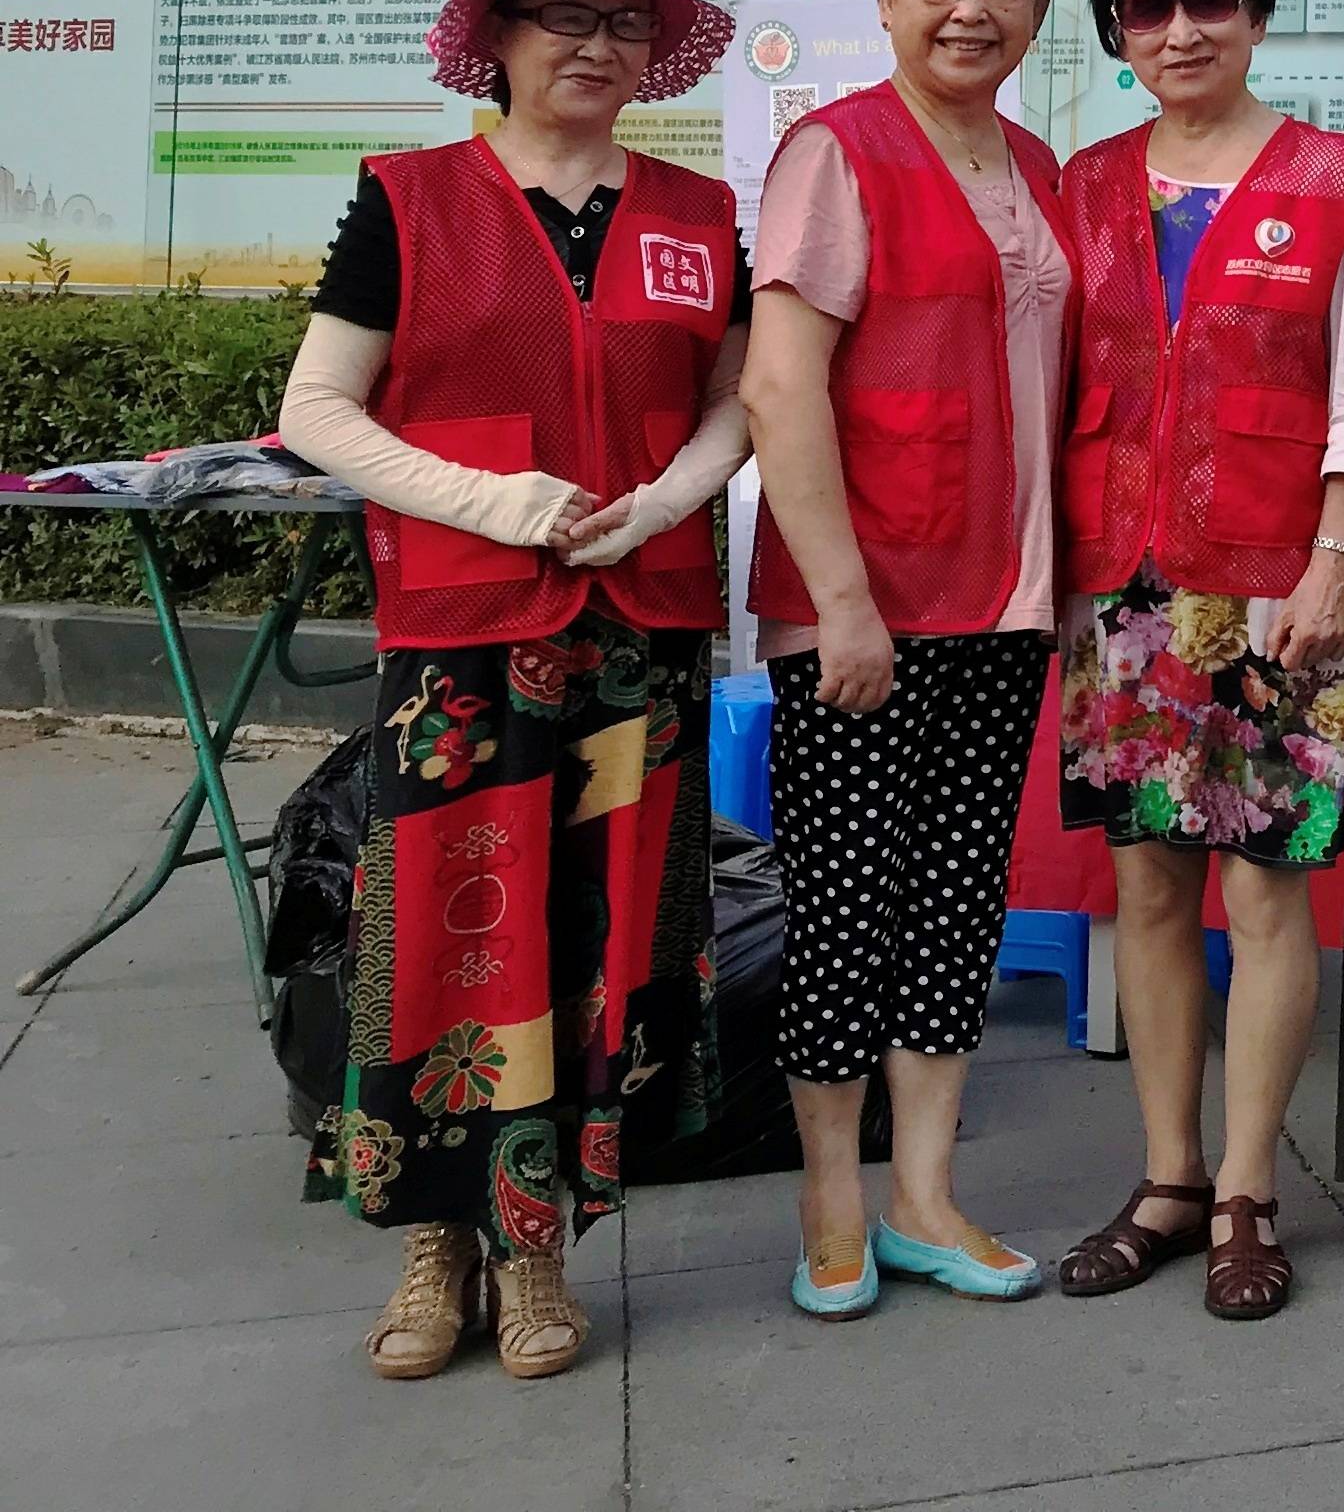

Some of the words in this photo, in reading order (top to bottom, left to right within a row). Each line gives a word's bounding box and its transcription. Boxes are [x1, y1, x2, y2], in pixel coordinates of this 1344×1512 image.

[0, 18, 115, 52] 美好家园
[813, 39, 861, 57] What
[866, 38, 881, 53] is
